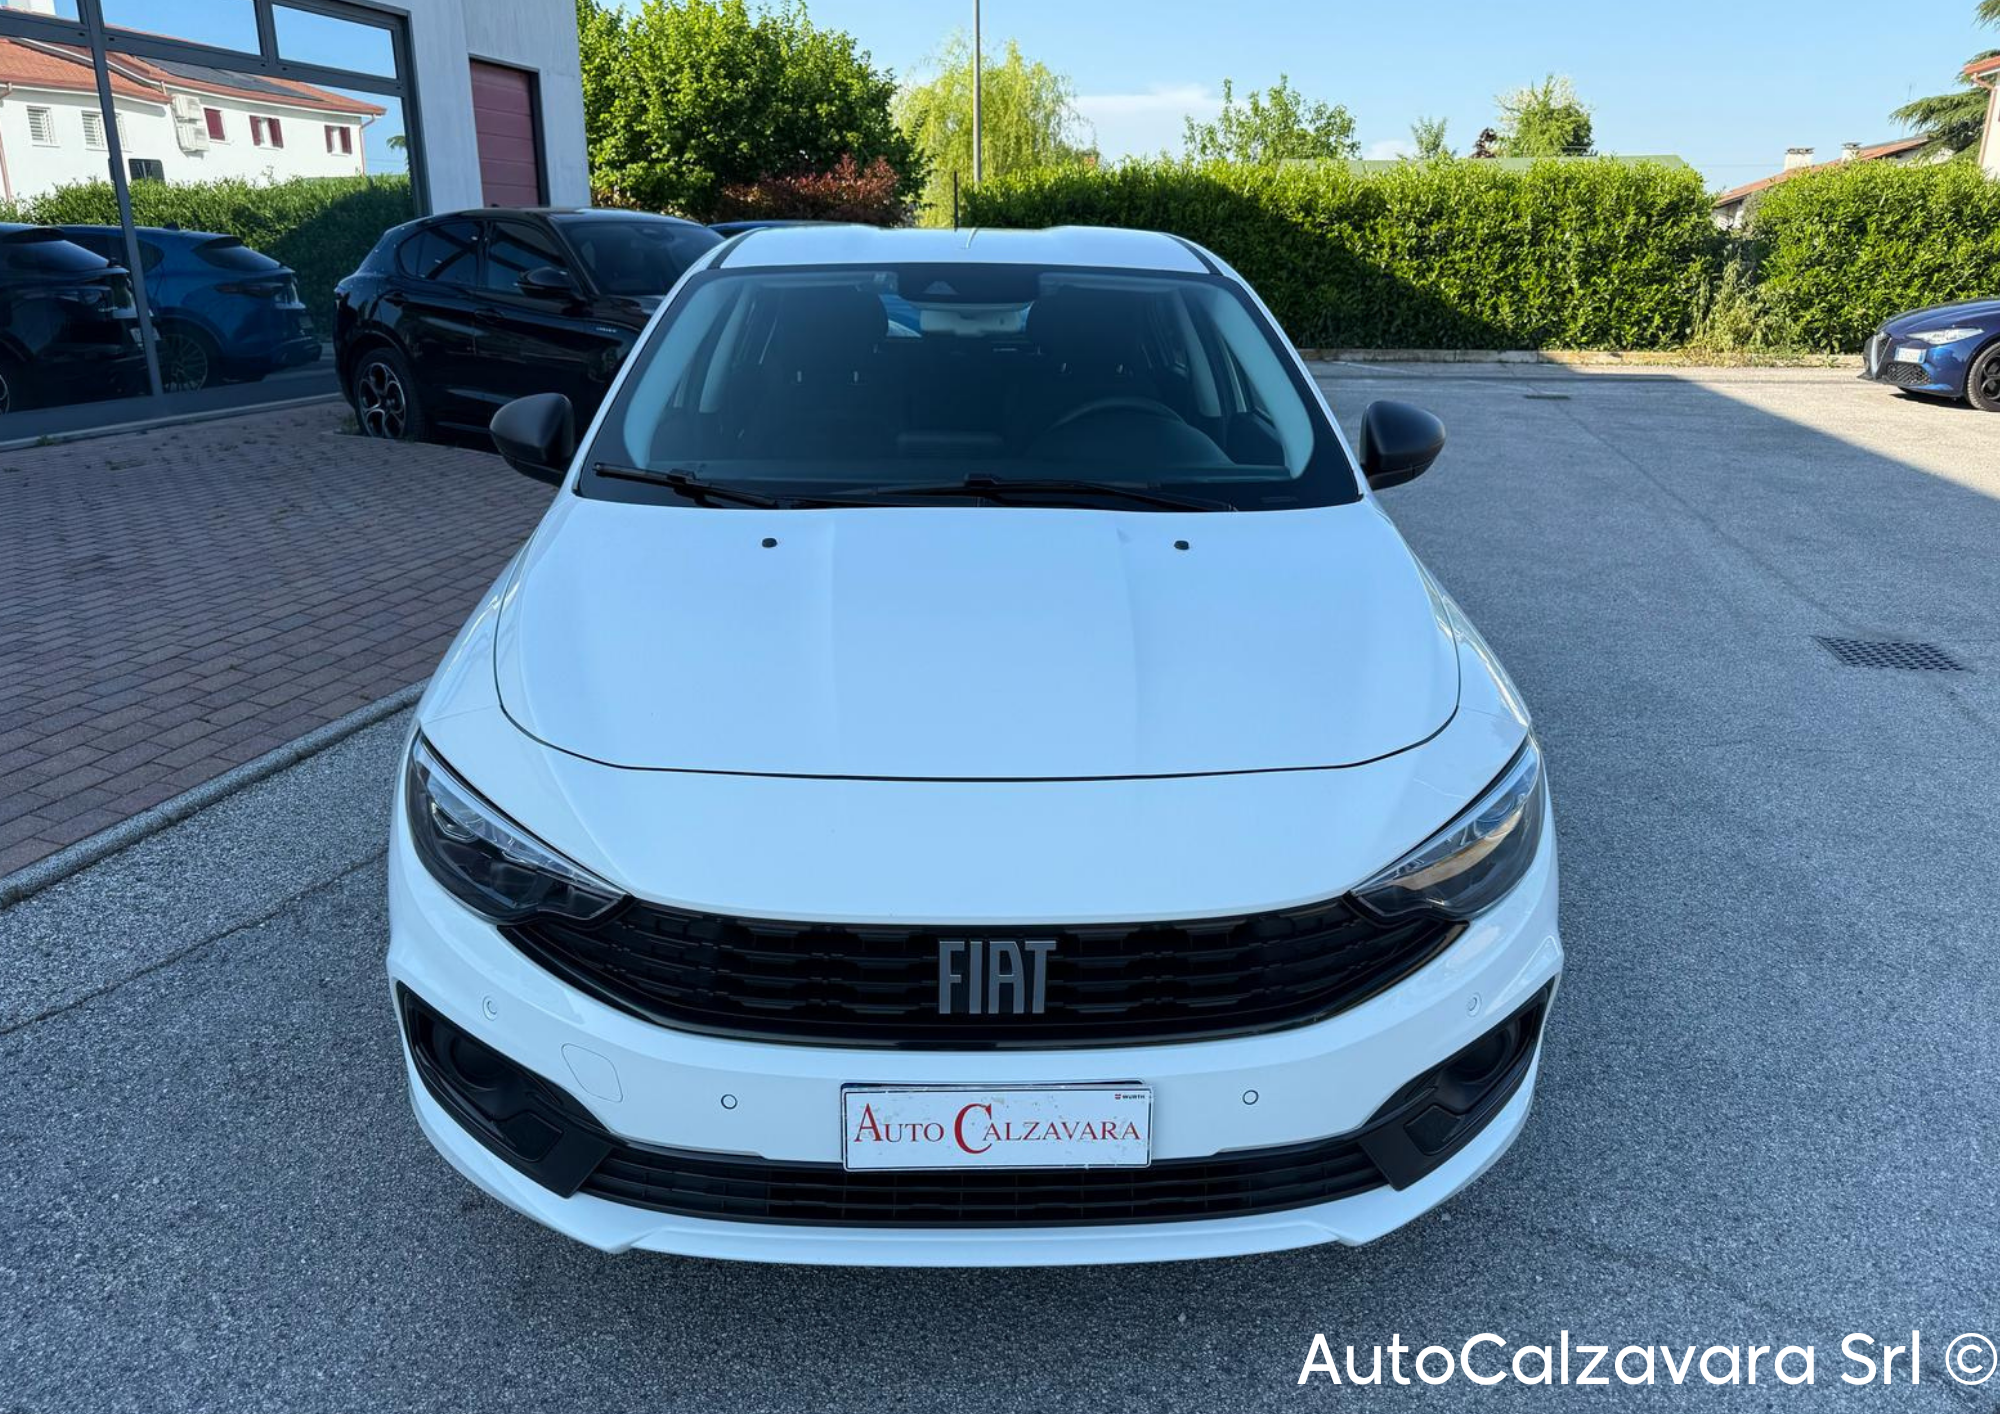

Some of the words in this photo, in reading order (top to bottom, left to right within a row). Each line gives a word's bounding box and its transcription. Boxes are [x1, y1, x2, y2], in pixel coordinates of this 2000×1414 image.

[939, 940, 1057, 1014] FIAT
[853, 1103, 945, 1143] AUTO
[954, 1103, 1141, 1154] CALZAVARA
